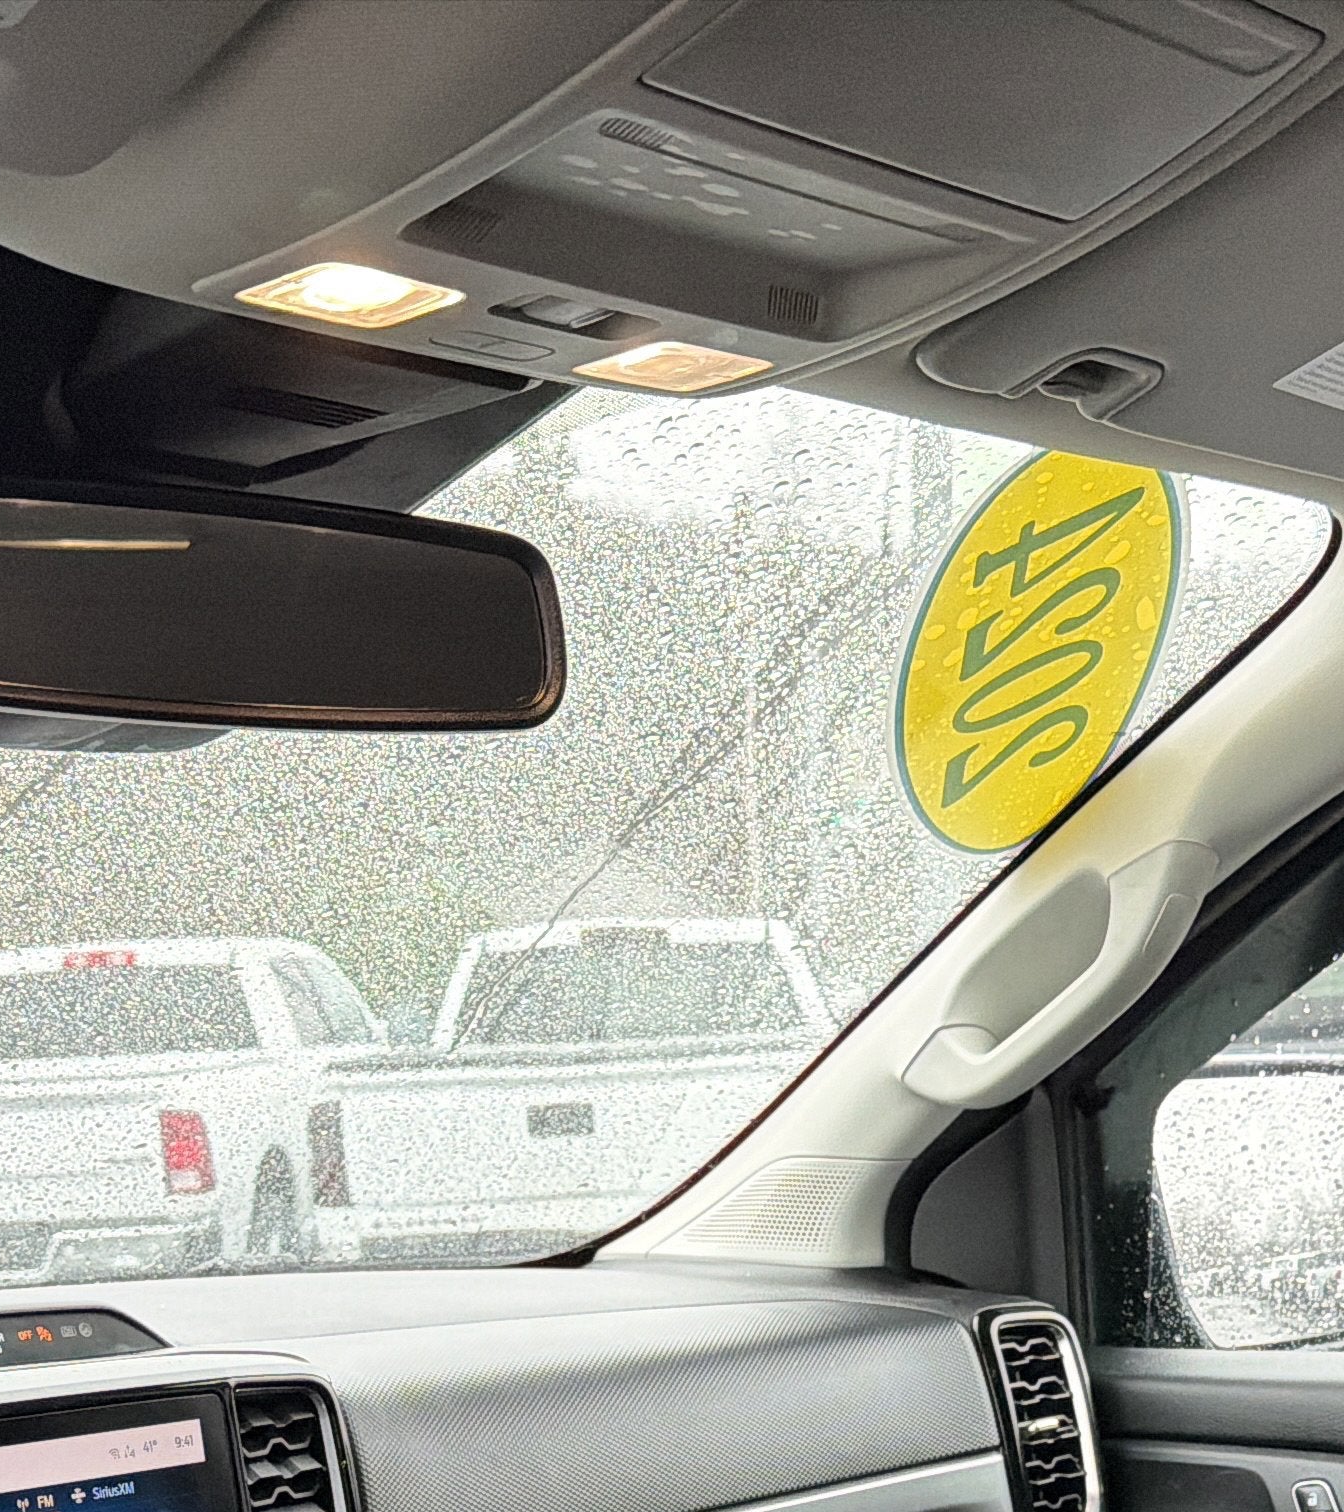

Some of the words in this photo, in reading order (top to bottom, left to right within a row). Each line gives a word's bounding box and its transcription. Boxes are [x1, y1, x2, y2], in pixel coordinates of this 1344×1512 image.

[17, 1329, 33, 1341] OFF
[174, 1435, 194, 1449] 9:41
[37, 1494, 54, 1509] FM
[92, 1481, 135, 1500] SiriusXM
